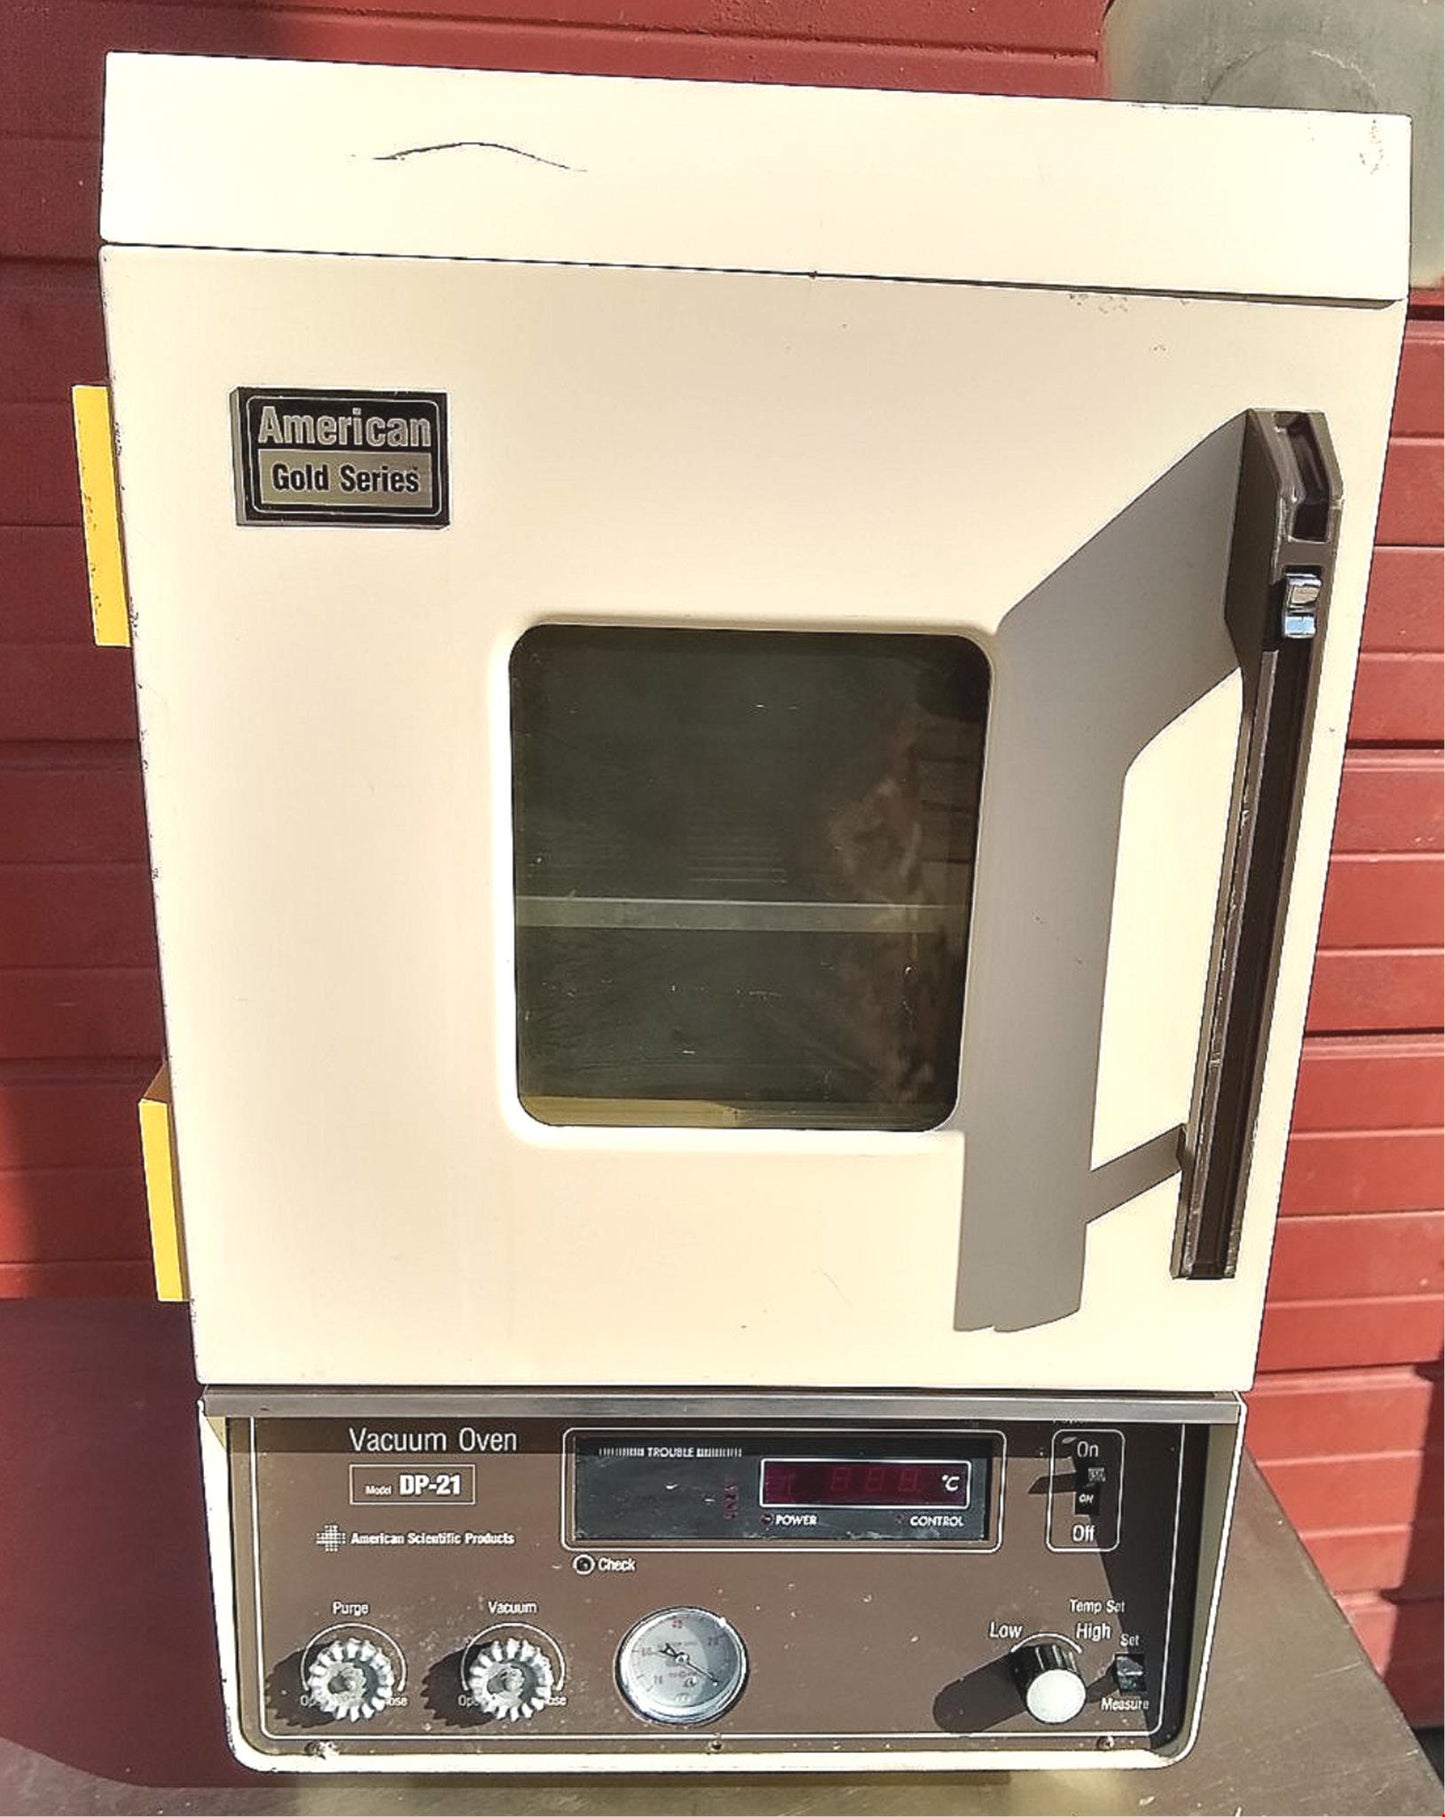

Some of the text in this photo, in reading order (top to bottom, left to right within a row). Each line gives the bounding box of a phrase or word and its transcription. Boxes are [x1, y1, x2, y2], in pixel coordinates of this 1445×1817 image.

[257, 405, 432, 447] American
[272, 463, 420, 492] Gold Series
[349, 1427, 518, 1451] Vacuum Oven
[647, 1447, 694, 1458] TROUBLE
[1077, 1441, 1099, 1457] On
[365, 1474, 461, 1496] Model DP-21
[775, 1515, 817, 1526] POWER
[910, 1515, 964, 1527] CONTROL
[351, 1532, 515, 1545] American Scientific Products
[1072, 1525, 1095, 1542] Off
[598, 1557, 636, 1572] Check
[332, 1601, 369, 1616] Purge
[488, 1601, 538, 1614] Vacuum
[1070, 1600, 1125, 1613] Temp Set
[990, 1622, 1023, 1638] Low
[1076, 1623, 1111, 1641] High
[1120, 1634, 1139, 1646] Set
[1101, 1698, 1149, 1711] Measure
